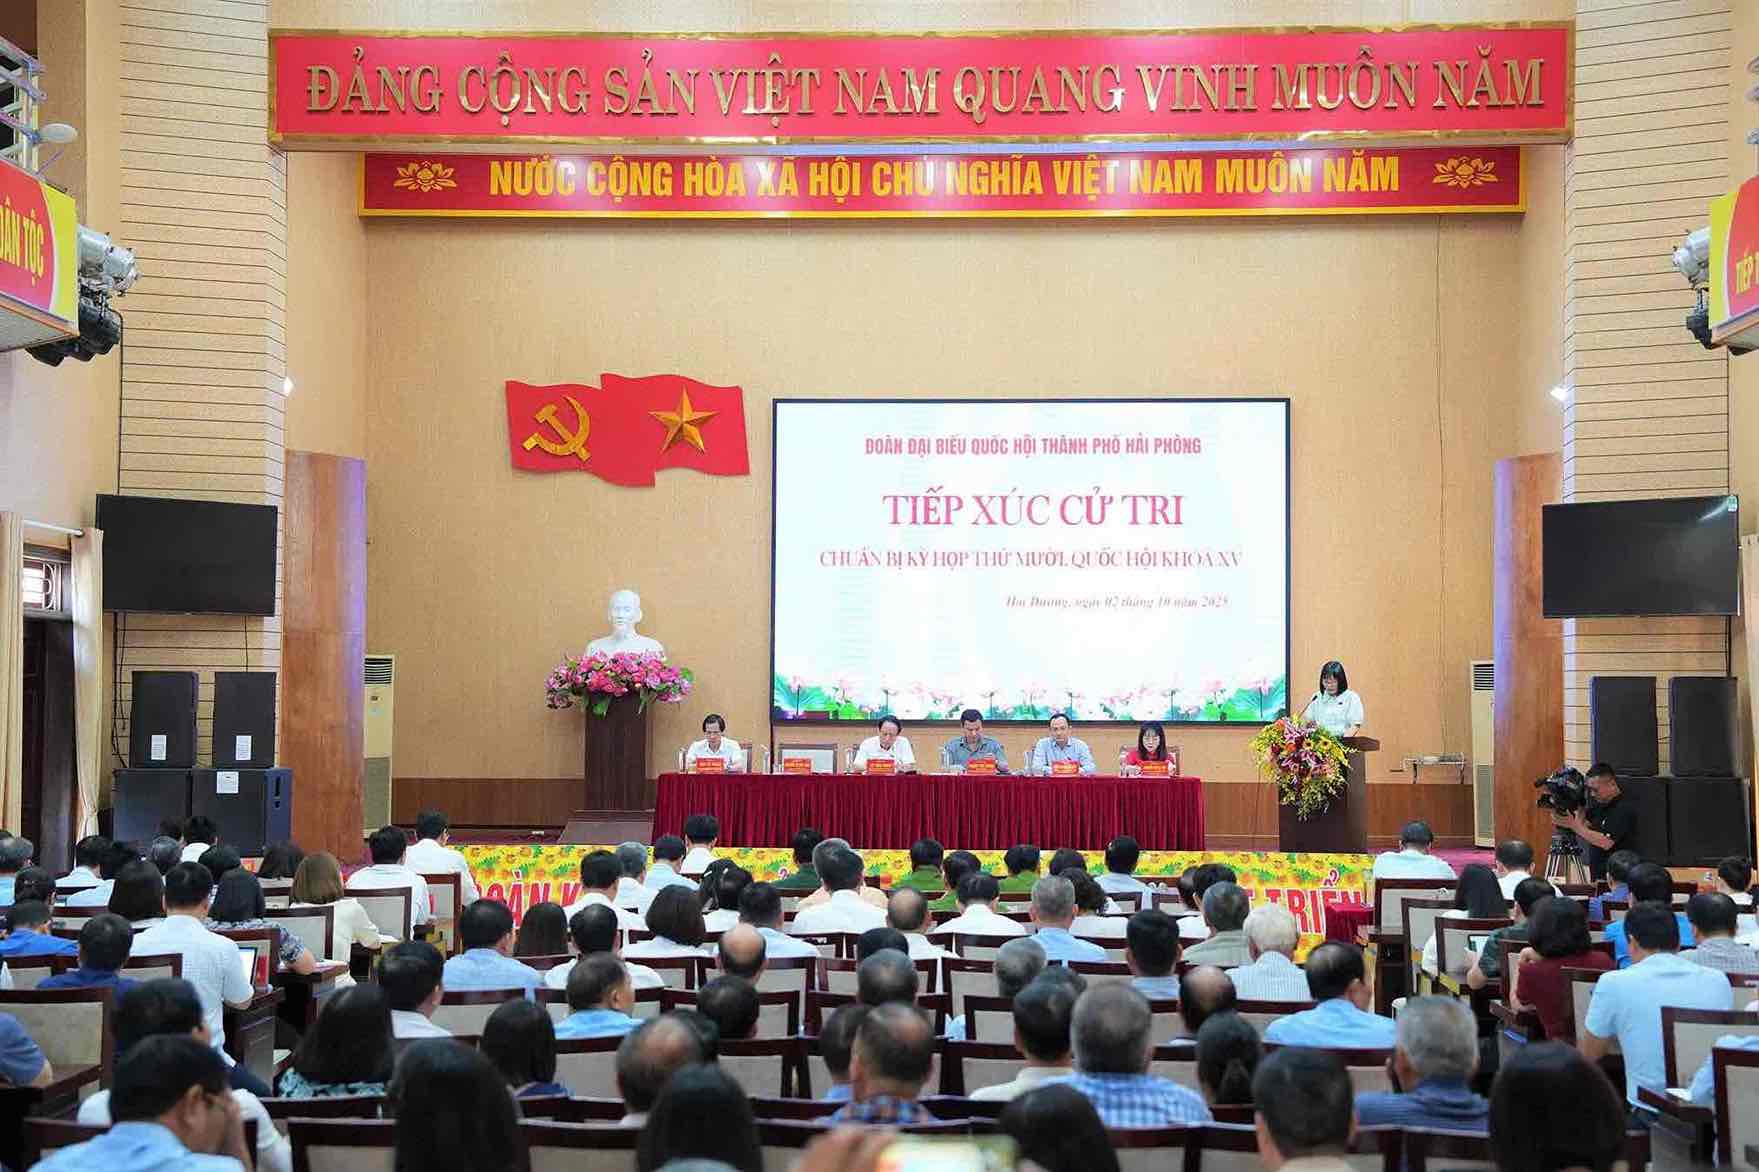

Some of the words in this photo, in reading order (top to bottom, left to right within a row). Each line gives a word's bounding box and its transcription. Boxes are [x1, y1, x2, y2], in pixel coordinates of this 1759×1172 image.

[306, 47, 443, 114] ĐẢNG
[457, 52, 591, 128] CỘNG
[603, 48, 699, 115] SẢN
[710, 53, 821, 128] VIỆT
[832, 66, 941, 115] NAM
[953, 64, 1126, 124] QUANG
[1135, 64, 1259, 114] VINH
[1271, 45, 1418, 112] MUÔN
[1433, 45, 1546, 110] NĂM
[490, 154, 575, 197] NƯỚC
[587, 154, 673, 203] CỘNG
[684, 154, 746, 197] HÒA
[756, 155, 798, 197] XÃ
[808, 155, 861, 203] HỘI
[871, 155, 935, 196] CHỦ
[946, 154, 1044, 197] NGHĨA
[1052, 154, 1120, 201] VIỆT
[1130, 158, 1203, 194] NAM
[1215, 150, 1312, 194] MUÔN
[1323, 148, 1399, 193] NĂM
[23, 208, 44, 287] TỘC
[1013, 434, 1036, 458] HỘI
[1042, 434, 1088, 454] THÀNH
[1154, 433, 1201, 454] PHÒNG
[883, 486, 964, 526] TIẾP
[971, 487, 1050, 526] XÚC
[1059, 486, 1114, 526] CỬ
[1121, 495, 1184, 525] TRI
[1216, 551, 1242, 567] XV
